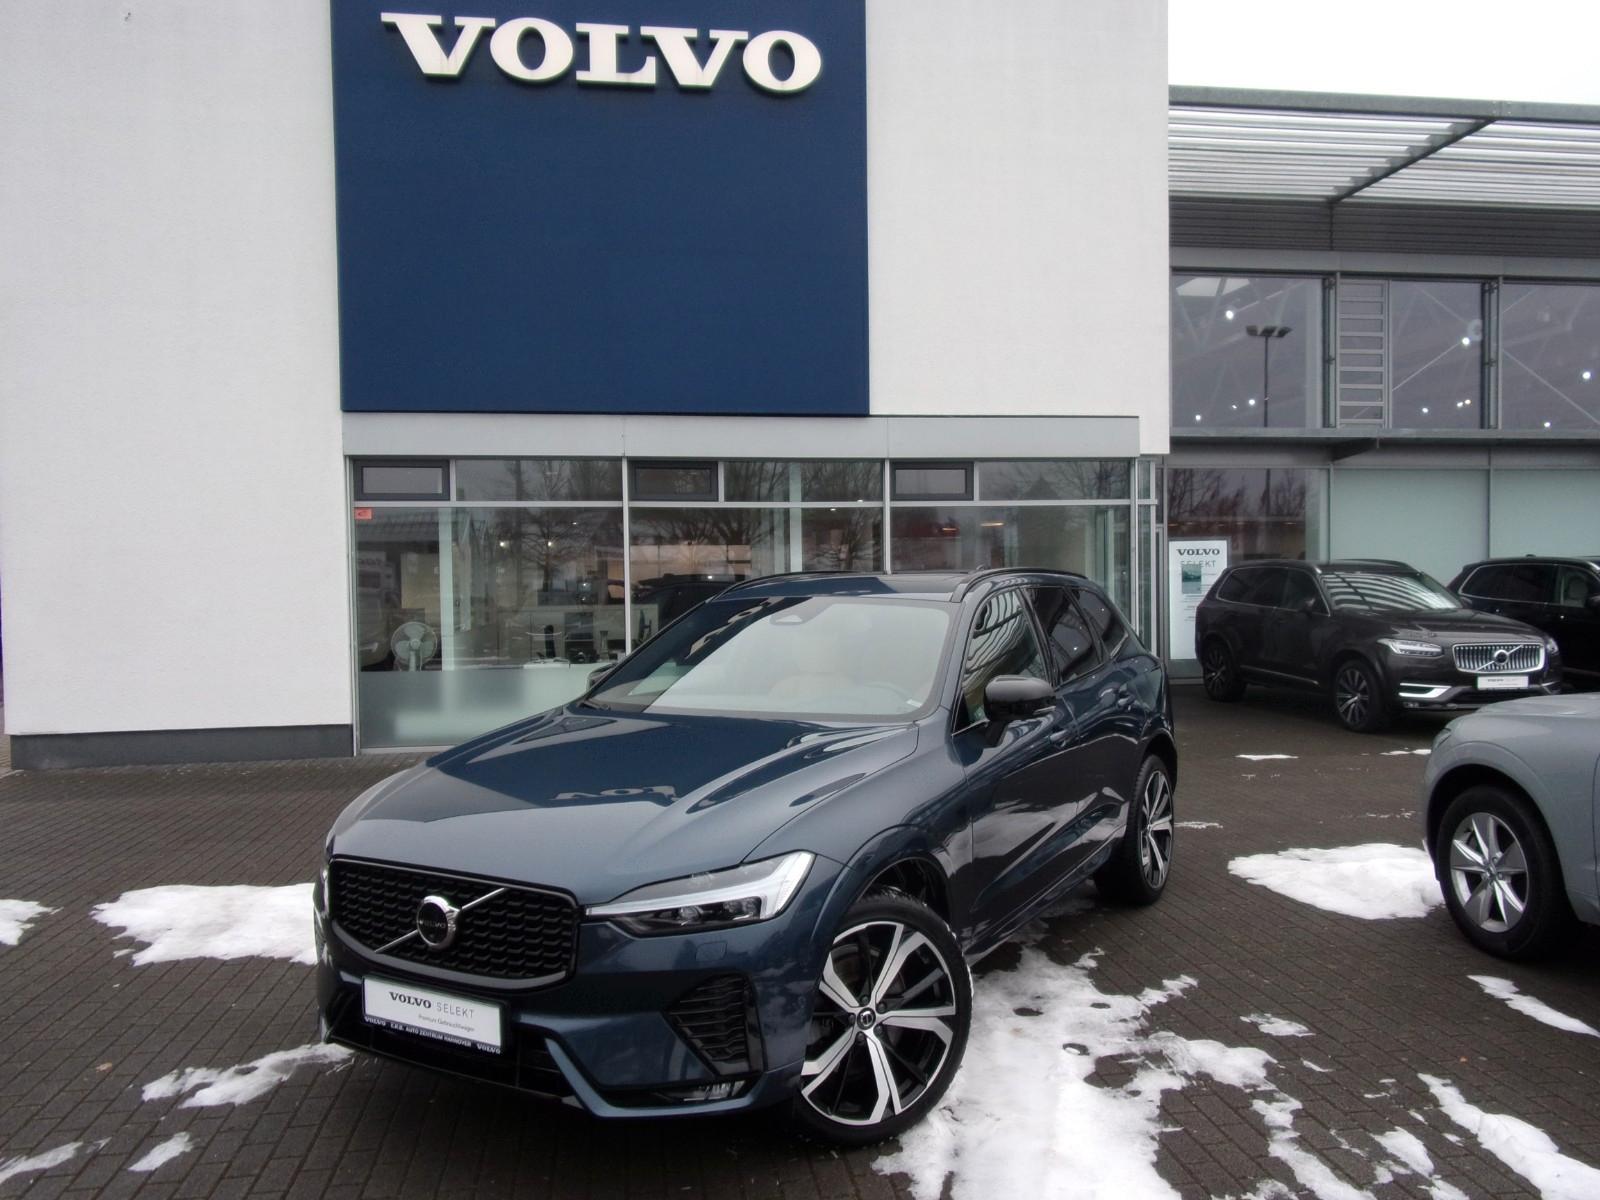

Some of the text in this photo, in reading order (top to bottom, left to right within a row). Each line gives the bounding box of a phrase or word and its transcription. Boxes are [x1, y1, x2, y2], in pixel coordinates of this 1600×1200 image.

[380, 12, 822, 94] VOLVO
[1176, 548, 1220, 556] VOLVO
[389, 991, 475, 1019] VOLVO SELEKT
[364, 1015, 386, 1026] VOLVO
[476, 1042, 501, 1055] VOLVO
